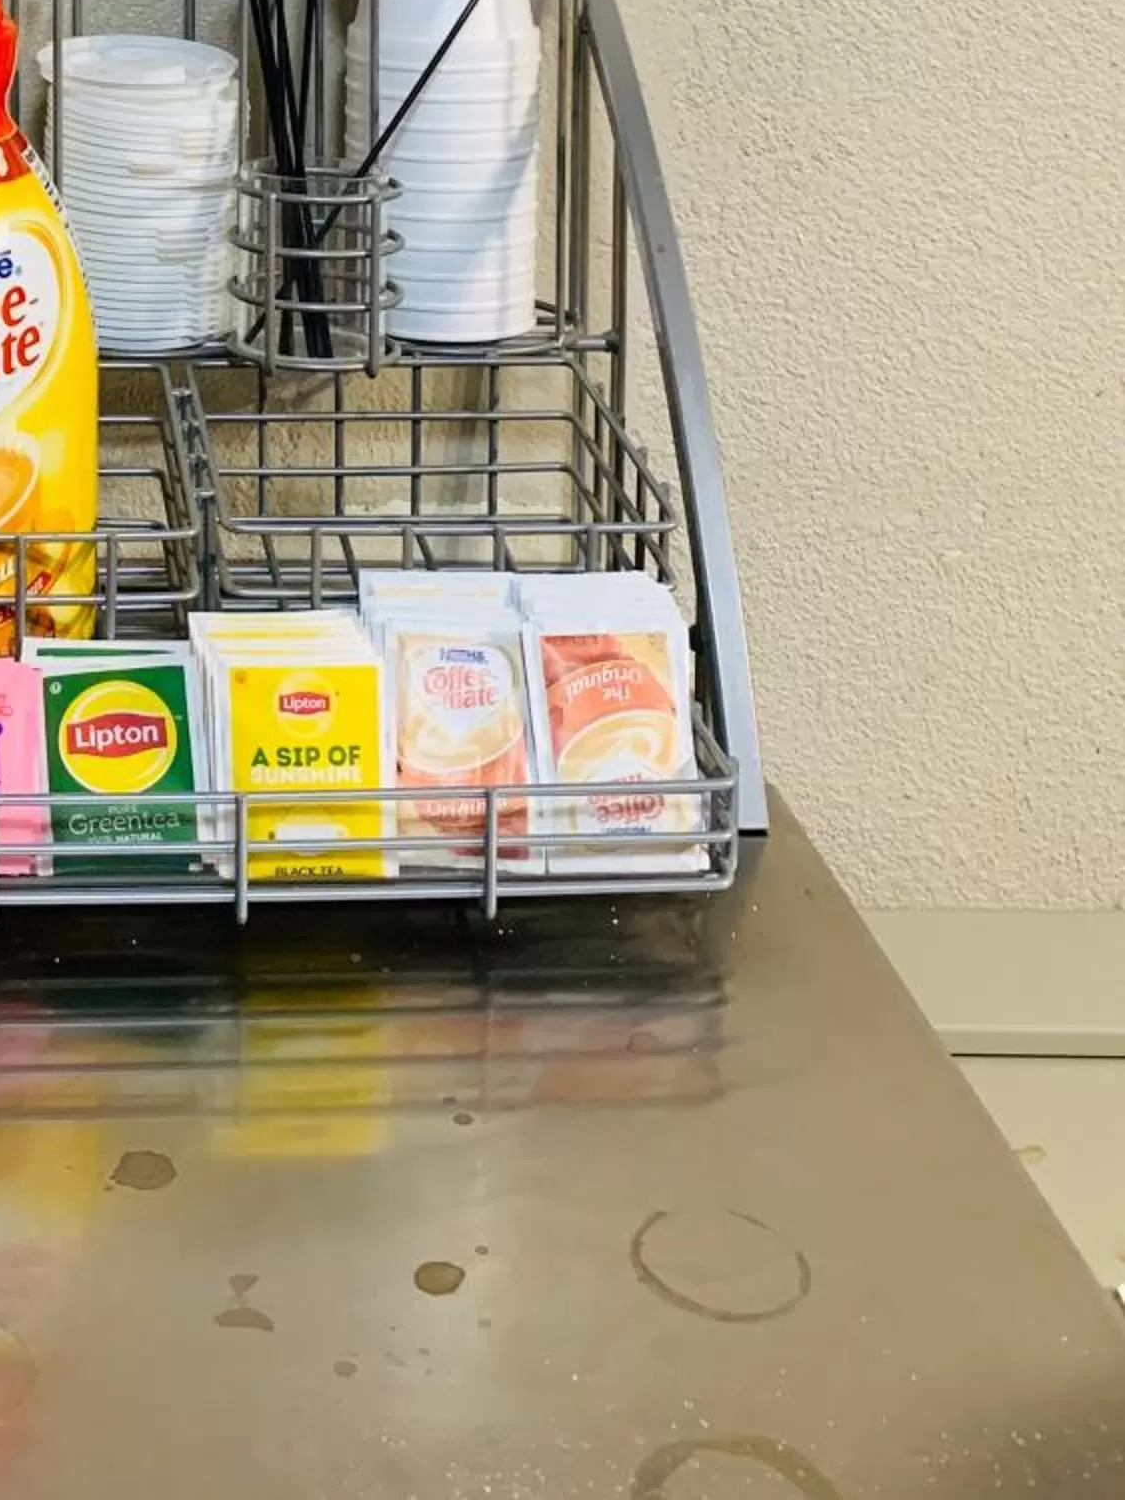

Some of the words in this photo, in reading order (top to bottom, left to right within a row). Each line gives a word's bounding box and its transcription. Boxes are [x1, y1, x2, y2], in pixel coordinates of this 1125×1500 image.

[566, 667, 642, 703] Original
[283, 697, 326, 712] Lipton
[75, 725, 160, 751] Lipton
[251, 747, 269, 767] A
[276, 746, 321, 767] SIP
[328, 745, 361, 766] OF
[275, 867, 315, 877] BLACK
[320, 865, 345, 877] TEA
